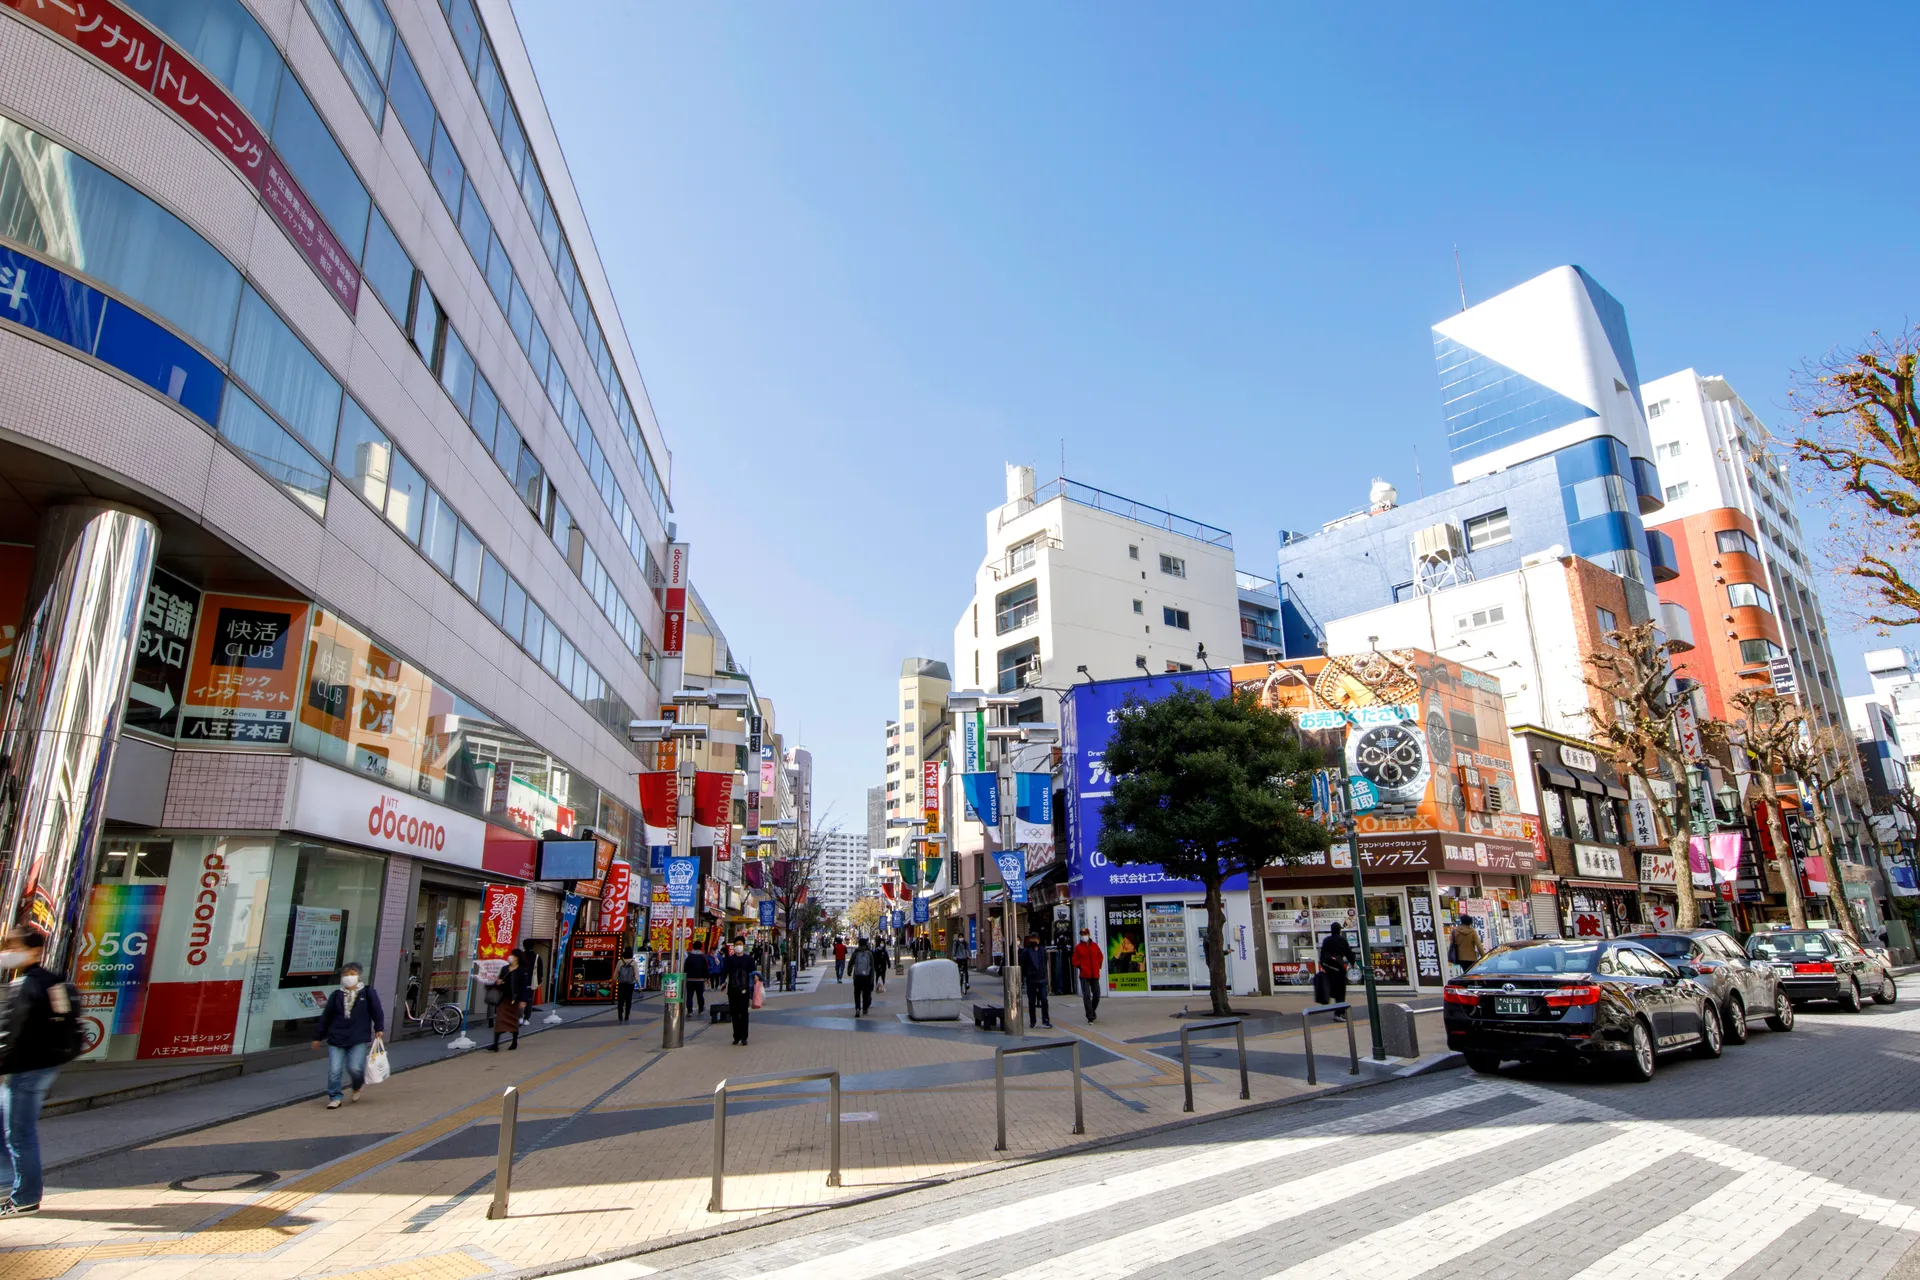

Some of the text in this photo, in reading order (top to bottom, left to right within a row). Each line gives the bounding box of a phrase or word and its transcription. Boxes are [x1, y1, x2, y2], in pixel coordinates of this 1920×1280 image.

[160, 61, 263, 167] トレーニング
[672, 548, 682, 584] docomo
[226, 620, 278, 641] 快活
[224, 642, 274, 659] CLUB
[321, 650, 346, 684] 快活
[217, 673, 271, 687] コミック
[317, 679, 343, 704] CLUB
[193, 687, 290, 704] インターネット
[269, 710, 283, 720] 2F
[189, 722, 284, 741] 八王子本店
[967, 721, 977, 772] FamilyMart
[717, 775, 732, 813] TOKYO
[926, 764, 938, 808] スギ薬局
[989, 787, 997, 807] TOKYO
[1042, 787, 1050, 805] TOKYO
[387, 797, 399, 808] NTT
[666, 773, 678, 846] TOKYO 2020
[369, 795, 445, 851] docomo
[712, 816, 727, 847] 2020
[1354, 814, 1432, 834] OLEX
[1634, 802, 1650, 844] 手作り餃子
[1358, 840, 1428, 853] ブランドリサイクルショップ
[187, 853, 224, 966] docomo
[490, 894, 504, 920] フェア
[497, 893, 518, 944] 家計相談
[1411, 897, 1439, 976] 買取・販売
[1575, 913, 1608, 942] 餃
[97, 932, 149, 957] 5G
[82, 961, 135, 972] docomo
[152, 1044, 230, 1056] 八王子ユーロード店
[173, 1033, 231, 1043] ドコモショップ
